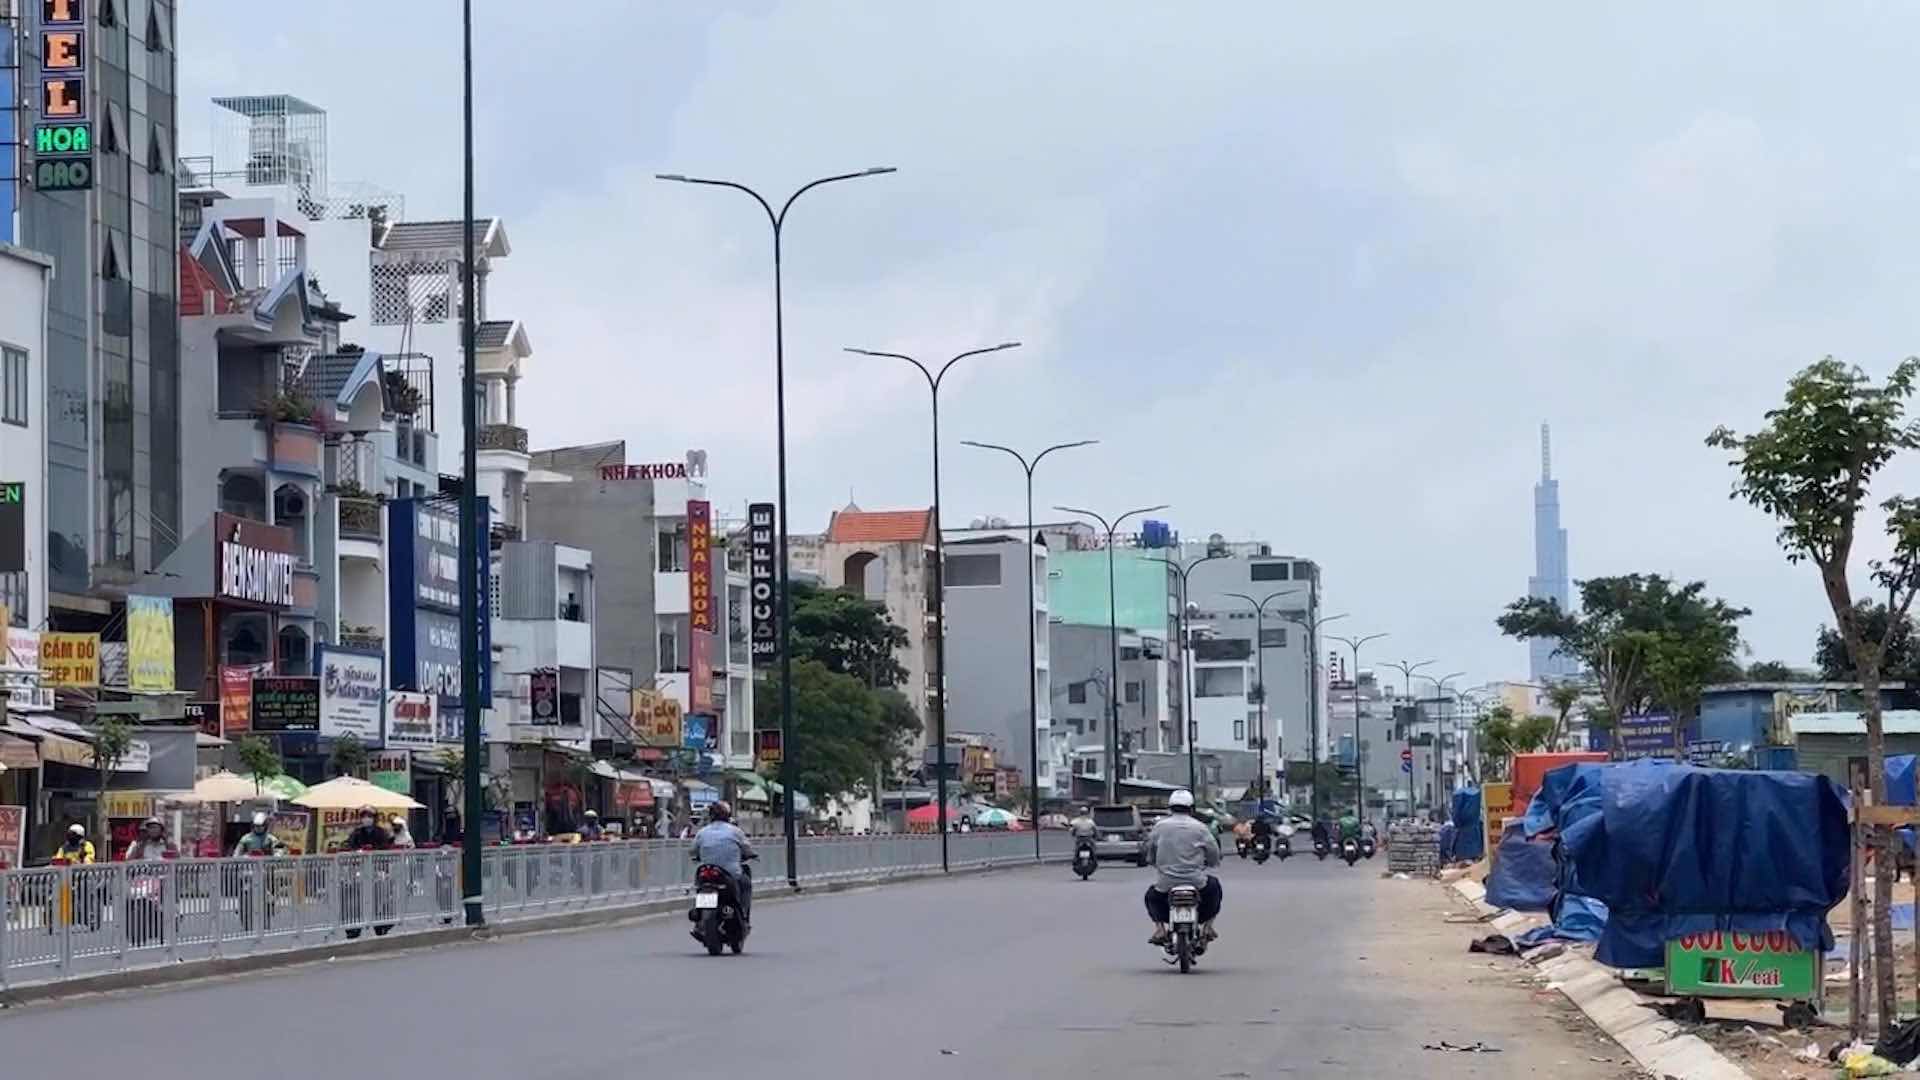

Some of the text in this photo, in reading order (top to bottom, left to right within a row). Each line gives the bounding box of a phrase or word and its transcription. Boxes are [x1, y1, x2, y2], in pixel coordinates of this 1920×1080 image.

[37, 126, 88, 152] HOA
[602, 463, 687, 481] NHA KHOA
[693, 524, 706, 626] NHA KHOA
[753, 511, 771, 620] COFFEE
